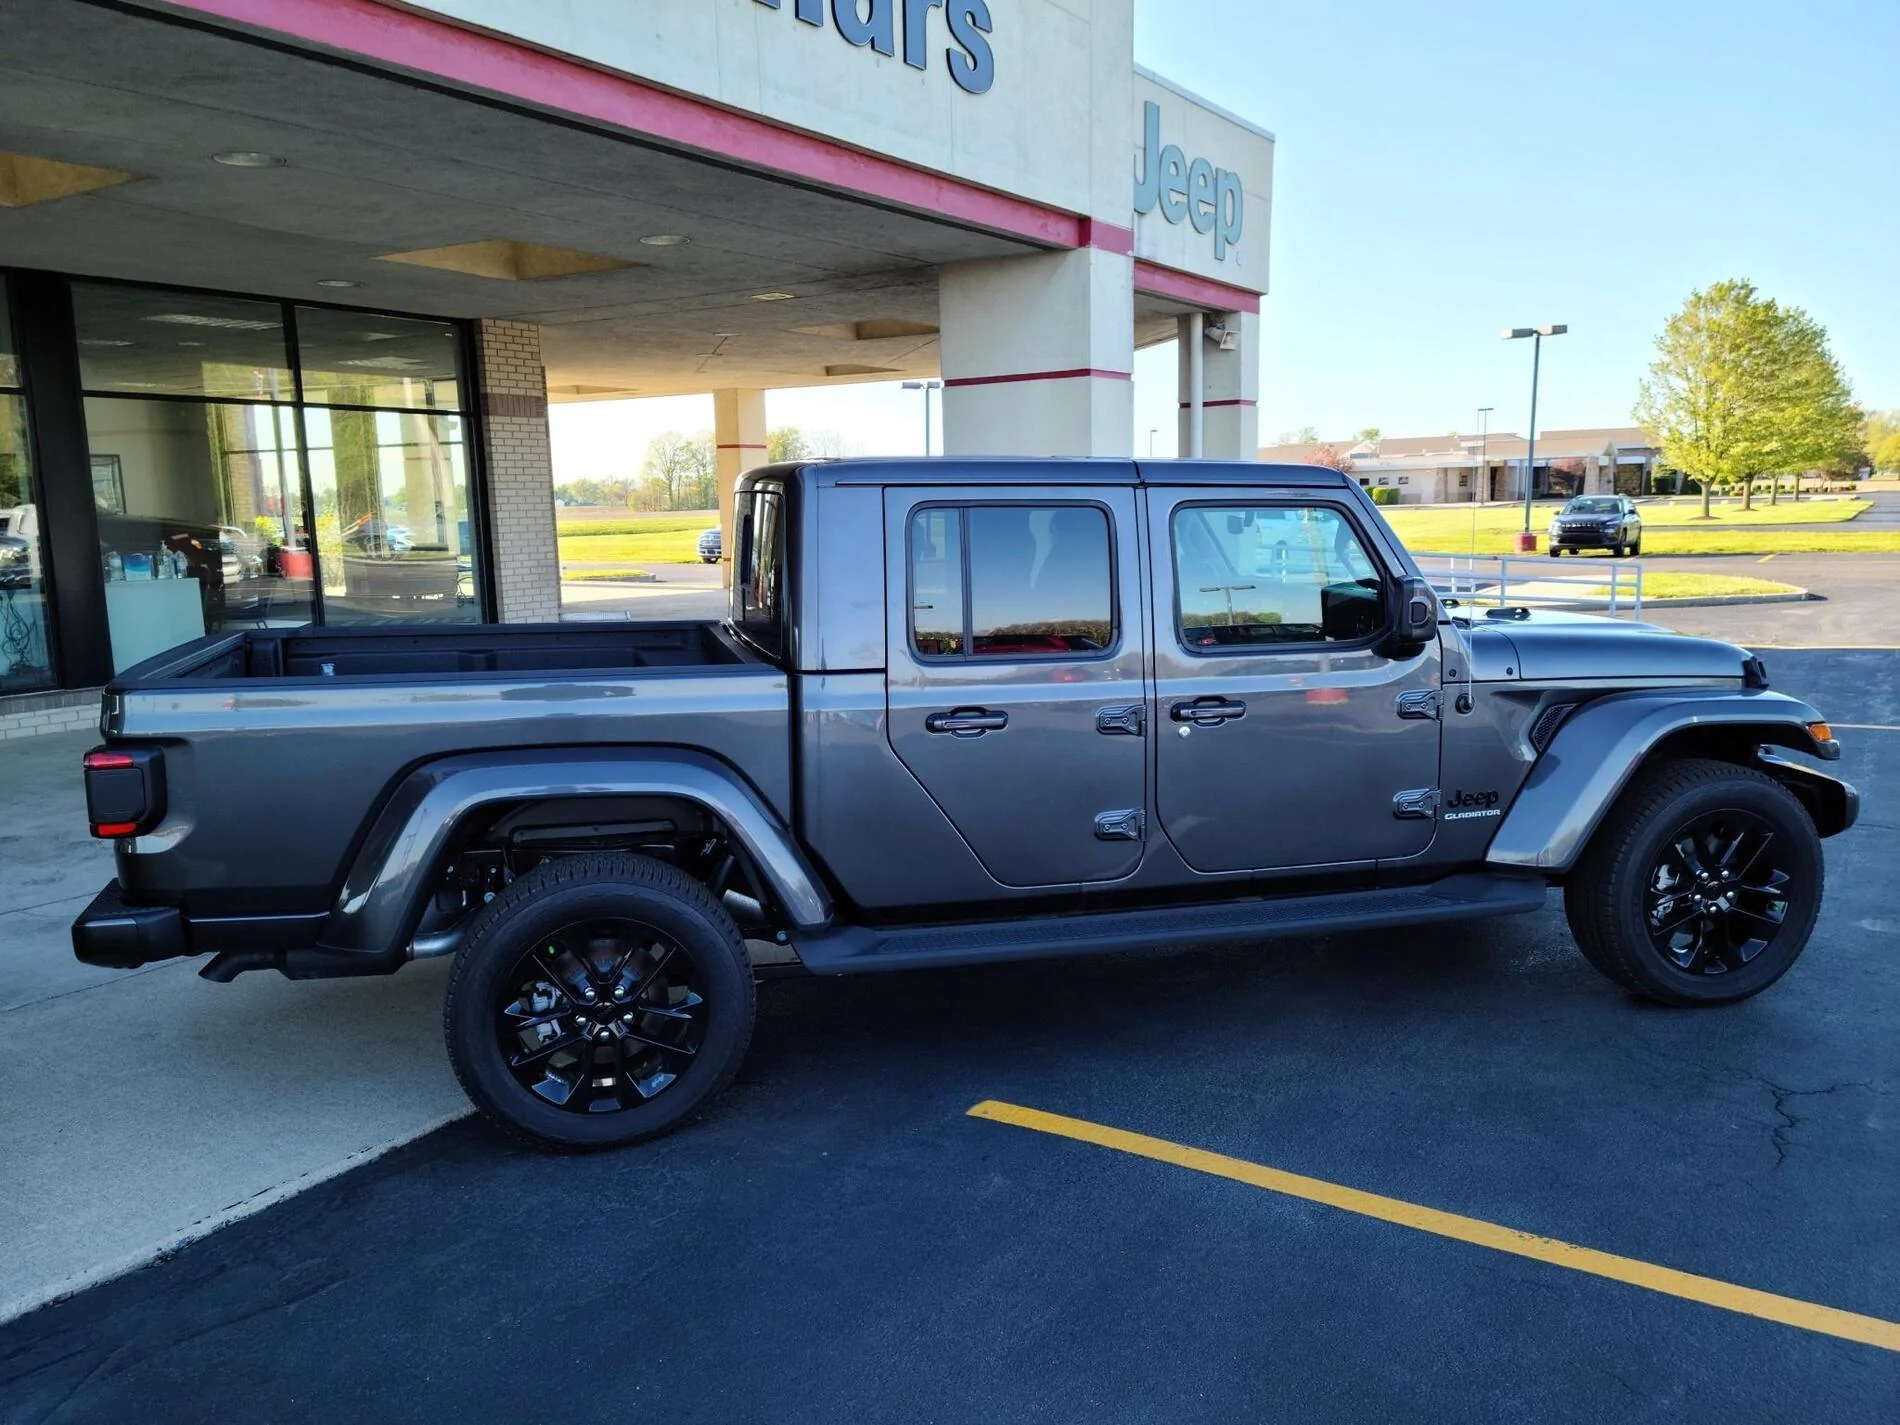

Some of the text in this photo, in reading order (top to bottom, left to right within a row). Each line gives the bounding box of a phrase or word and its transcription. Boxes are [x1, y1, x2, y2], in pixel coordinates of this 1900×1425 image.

[751, 0, 994, 94] ars
[1133, 100, 1243, 261] Jeep
[1444, 809, 1501, 820] GLADIATOR
[1447, 789, 1499, 808] Jeep
